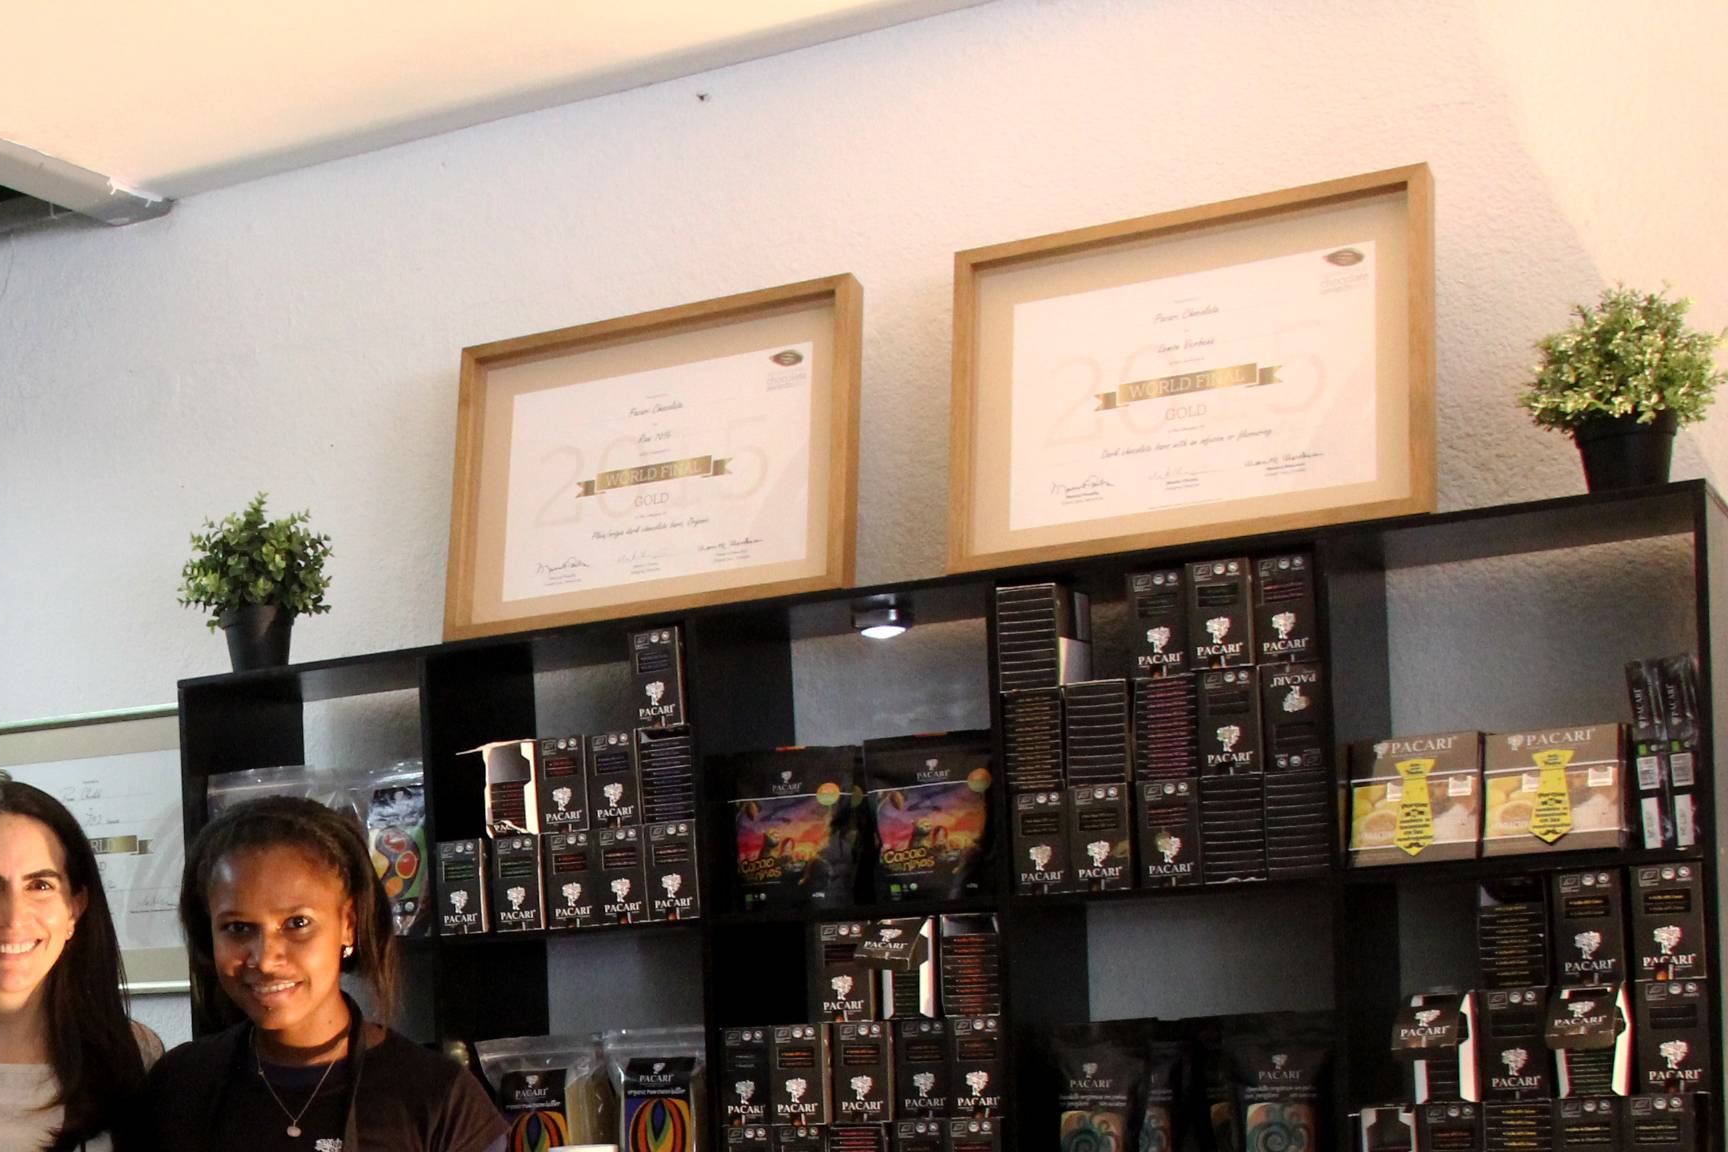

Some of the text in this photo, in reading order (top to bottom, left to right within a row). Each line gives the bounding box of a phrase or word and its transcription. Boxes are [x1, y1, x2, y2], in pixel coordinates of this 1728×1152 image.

[1130, 368, 1245, 398] WORLD FINAL
[1165, 404, 1207, 420] GOLD
[606, 459, 702, 486] WORLD FINAL
[634, 493, 669, 507] GOLD
[1392, 737, 1452, 753] PACARI
[1527, 731, 1590, 746] PACARI
